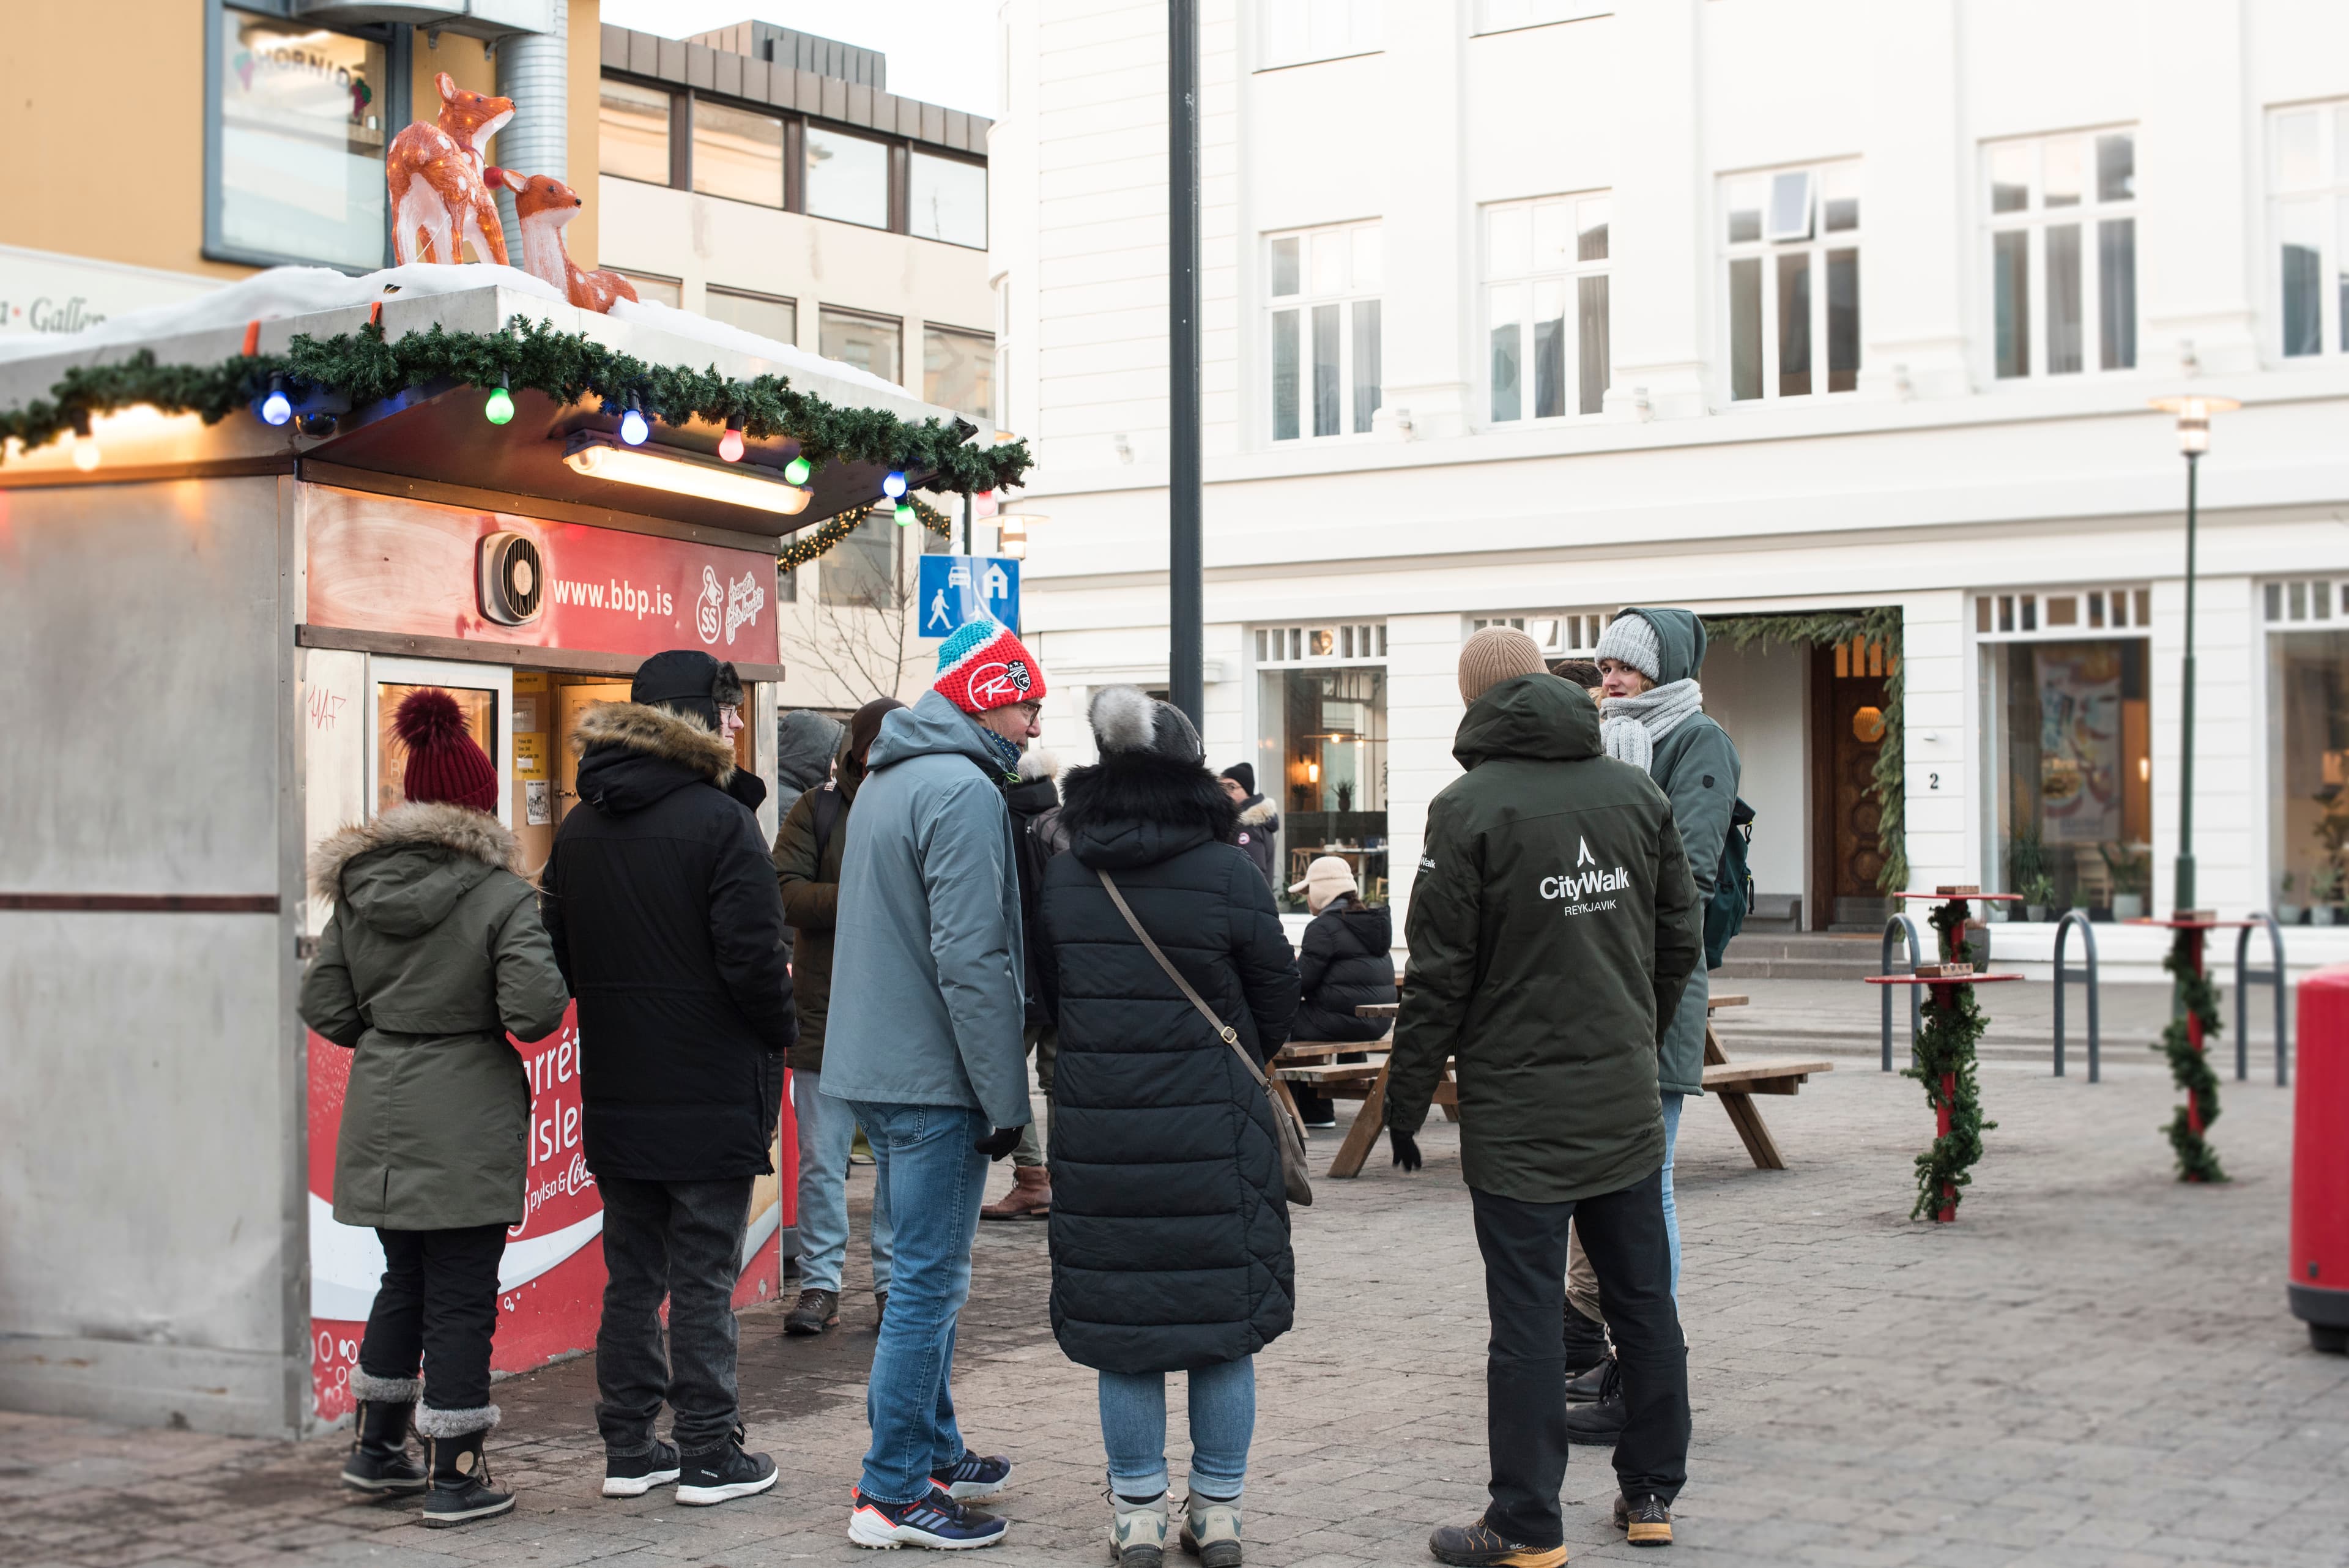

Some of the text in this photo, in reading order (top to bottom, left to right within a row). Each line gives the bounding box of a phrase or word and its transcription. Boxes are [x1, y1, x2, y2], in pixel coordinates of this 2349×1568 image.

[552, 579, 673, 620] www.bbp.is
[701, 606, 717, 634] SS
[1929, 772, 1939, 790] 2
[1540, 866, 1630, 901] CityWalk
[1564, 899, 1617, 916] REYKJAVIK
[530, 1098, 584, 1168] Ísle
[530, 1181, 557, 1214] pylsa
[558, 1171, 566, 1192] &
